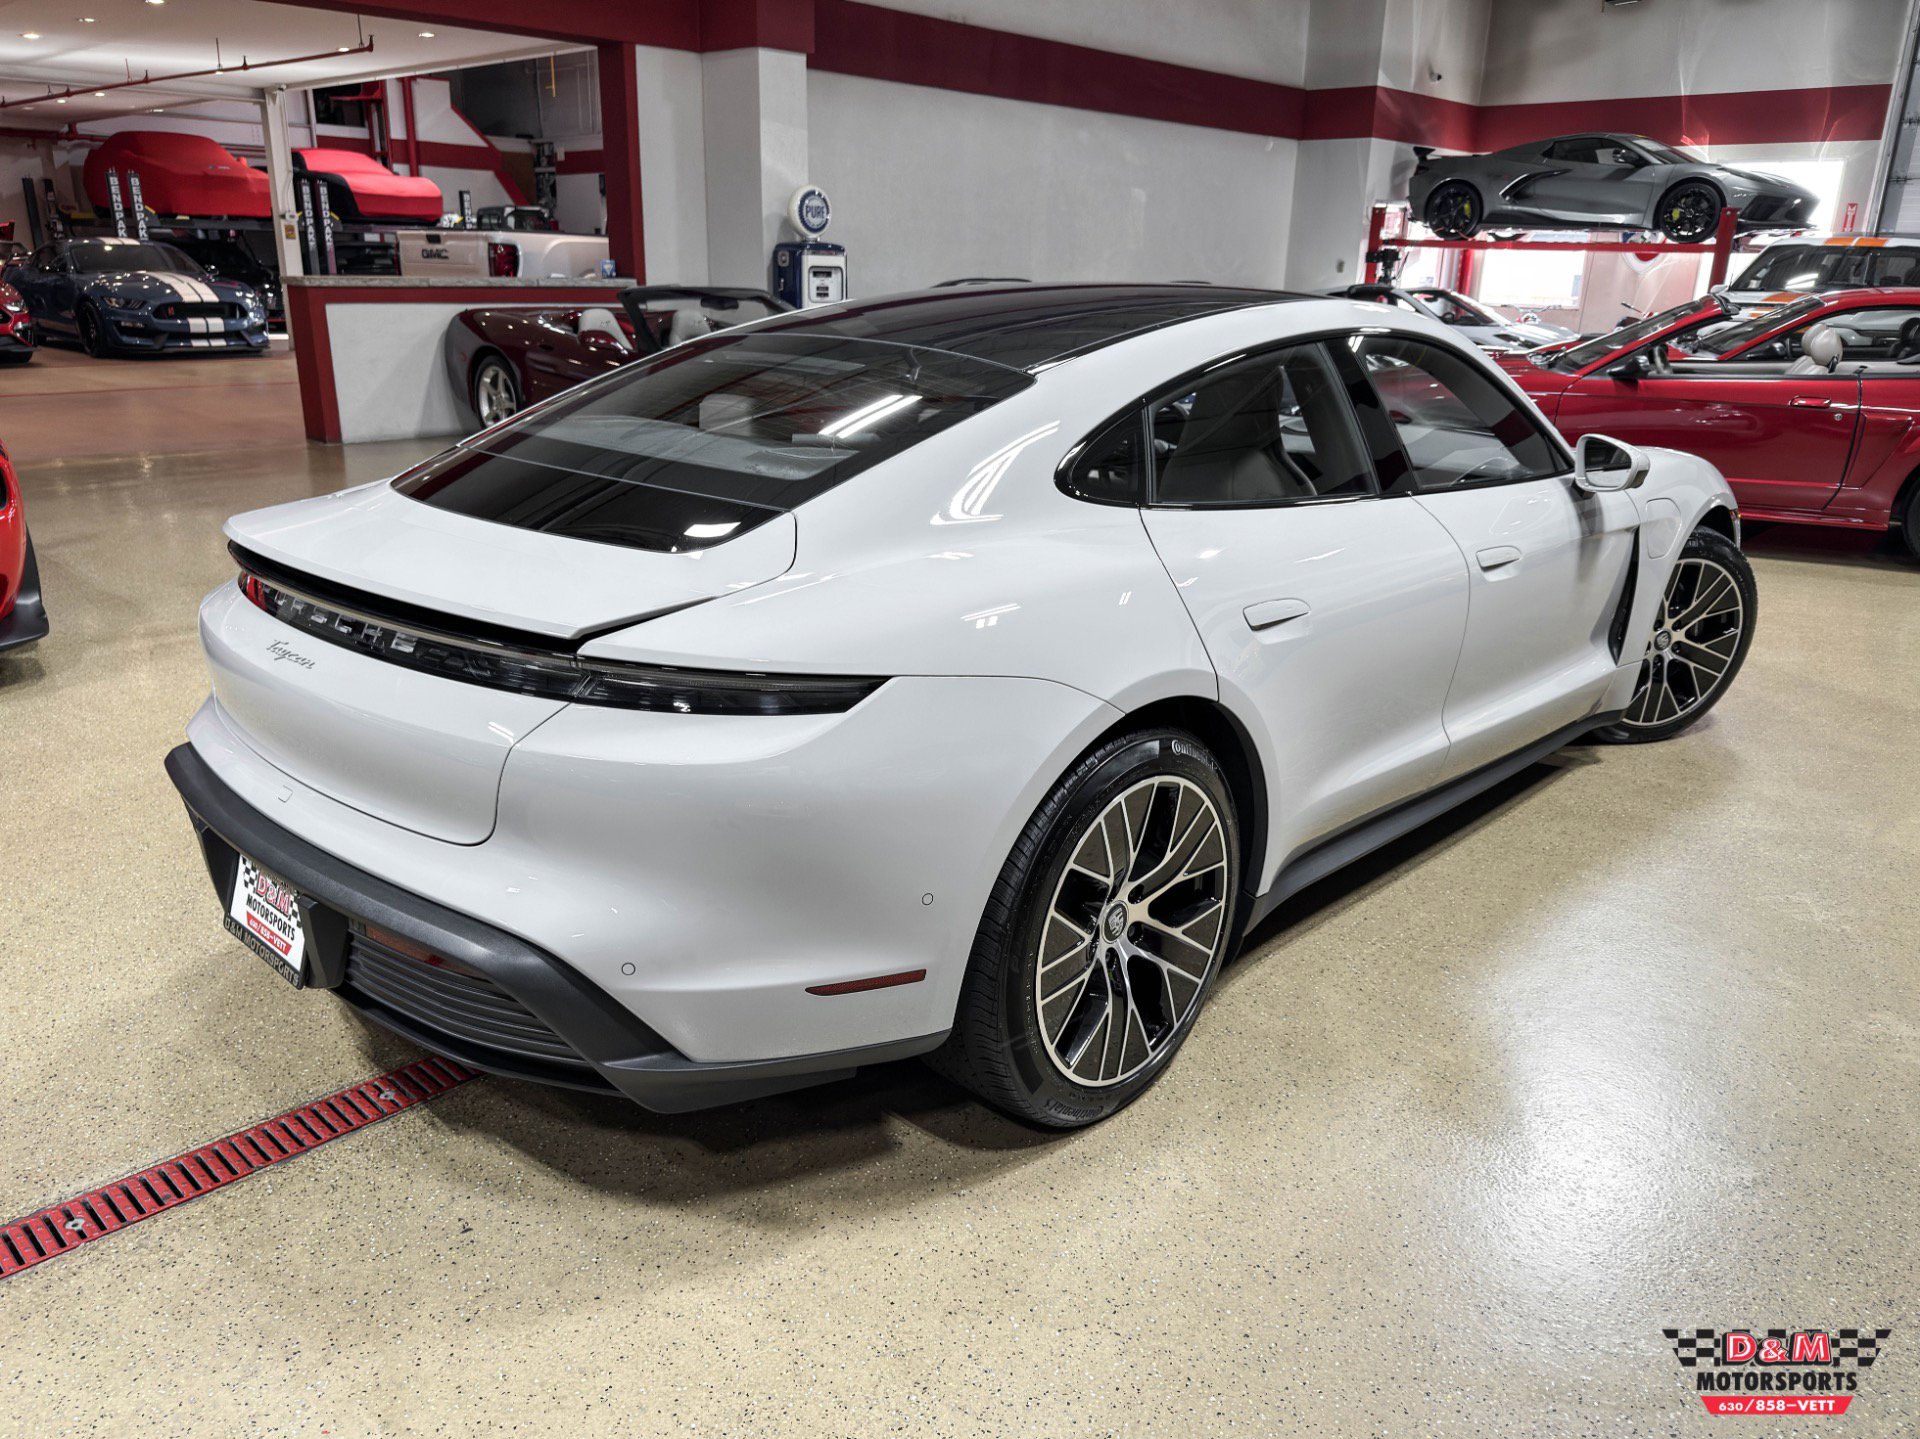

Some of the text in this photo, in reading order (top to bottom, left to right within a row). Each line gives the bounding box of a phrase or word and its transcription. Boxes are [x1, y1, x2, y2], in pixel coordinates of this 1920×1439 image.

[109, 176, 127, 238] BENDPAK
[130, 177, 148, 238] BENDPAK
[302, 185, 316, 243] BENDPAK
[320, 186, 333, 243] BENDPAK
[805, 204, 826, 219] PURE
[421, 248, 449, 260] GMC
[266, 640, 315, 669] Taycan
[246, 893, 296, 941] MOTORSPORTS
[255, 873, 291, 916] D&M
[244, 932, 300, 986] MOTORSPORTS
